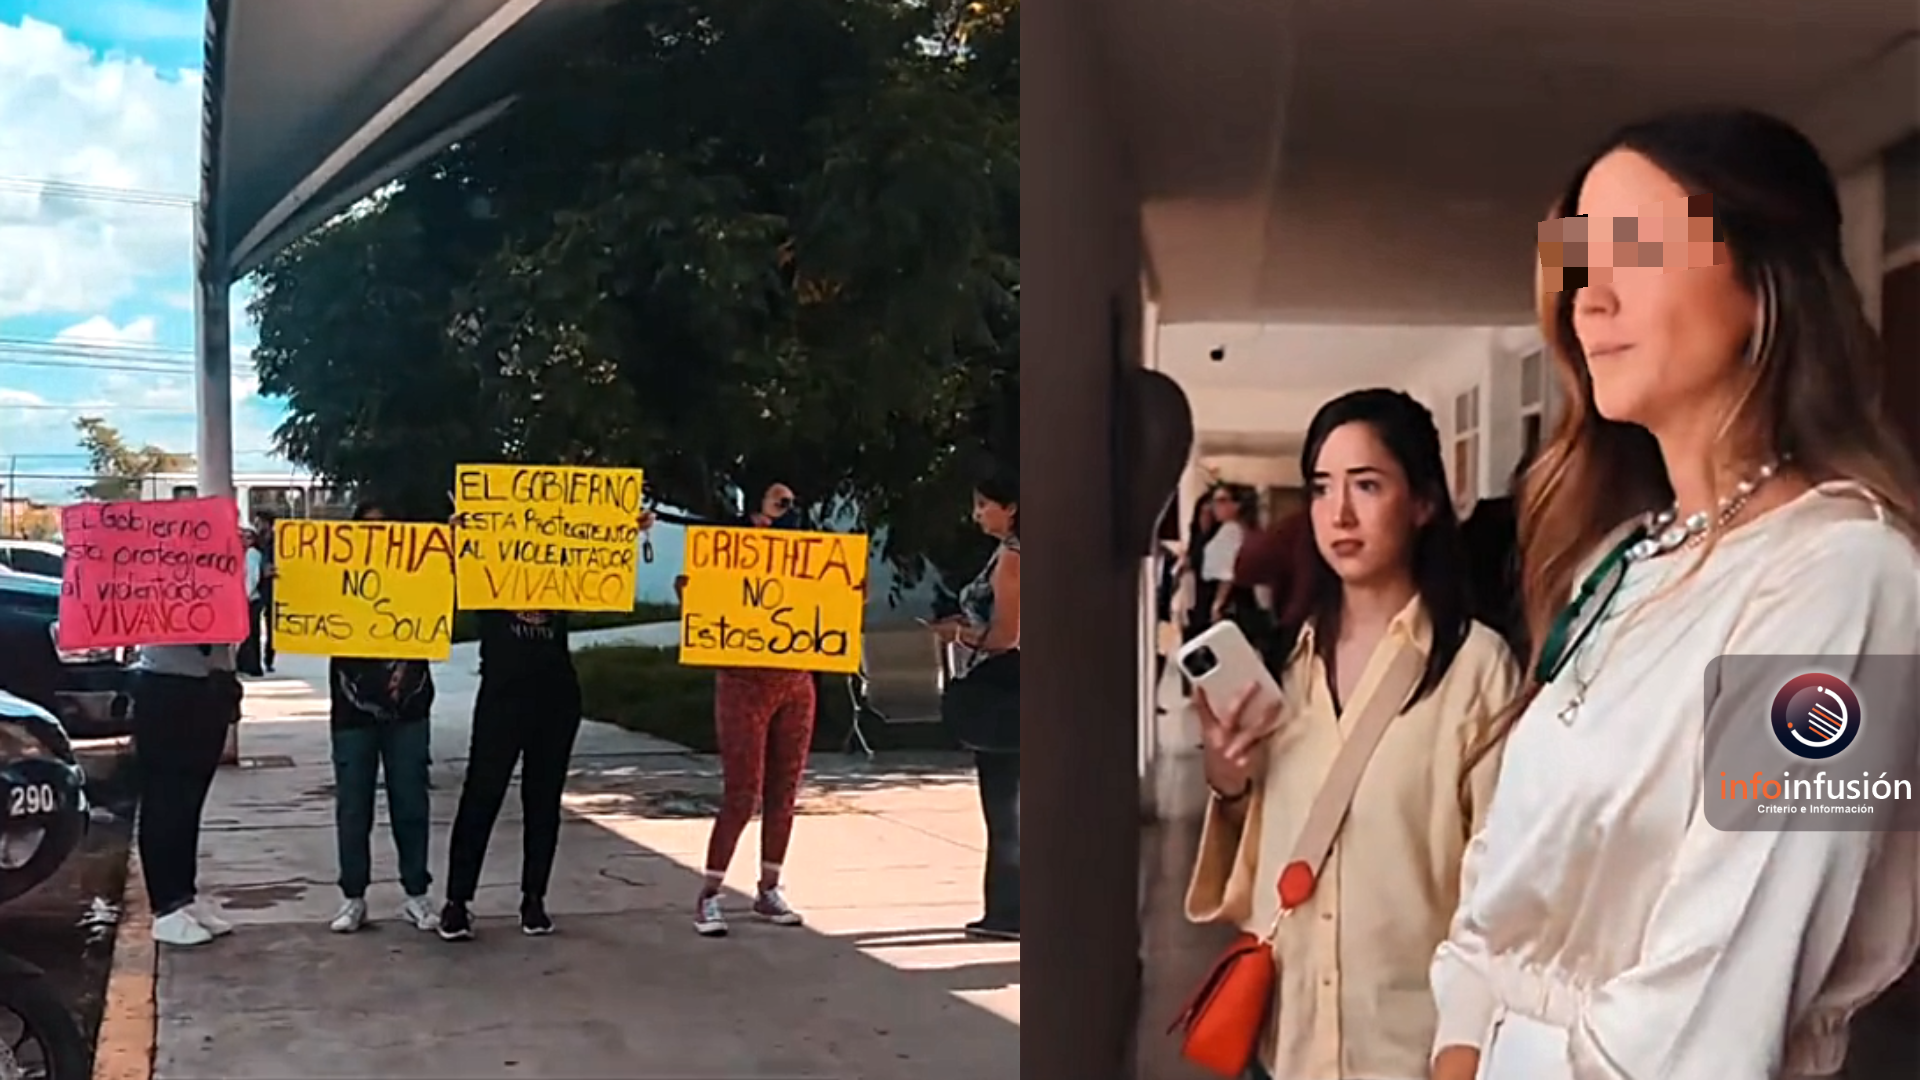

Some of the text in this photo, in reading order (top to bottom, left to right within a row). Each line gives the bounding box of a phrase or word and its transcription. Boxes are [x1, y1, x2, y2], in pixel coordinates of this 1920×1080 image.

[460, 469, 639, 514] EL GOBIERNO
[100, 502, 212, 540] Gobierno
[459, 511, 518, 533] ESTA
[278, 521, 457, 576] CRISTHIA
[458, 539, 634, 573] AL VIOLENTADOR
[692, 530, 852, 587] CRISTHIA
[341, 568, 382, 601] NO
[484, 565, 625, 606] VIVANCO
[742, 576, 785, 611] NO
[83, 602, 216, 636] VIVANCO
[274, 597, 451, 644] ESTAS SOLA
[684, 603, 848, 657] Estas Sola
[10, 783, 55, 817] 290
